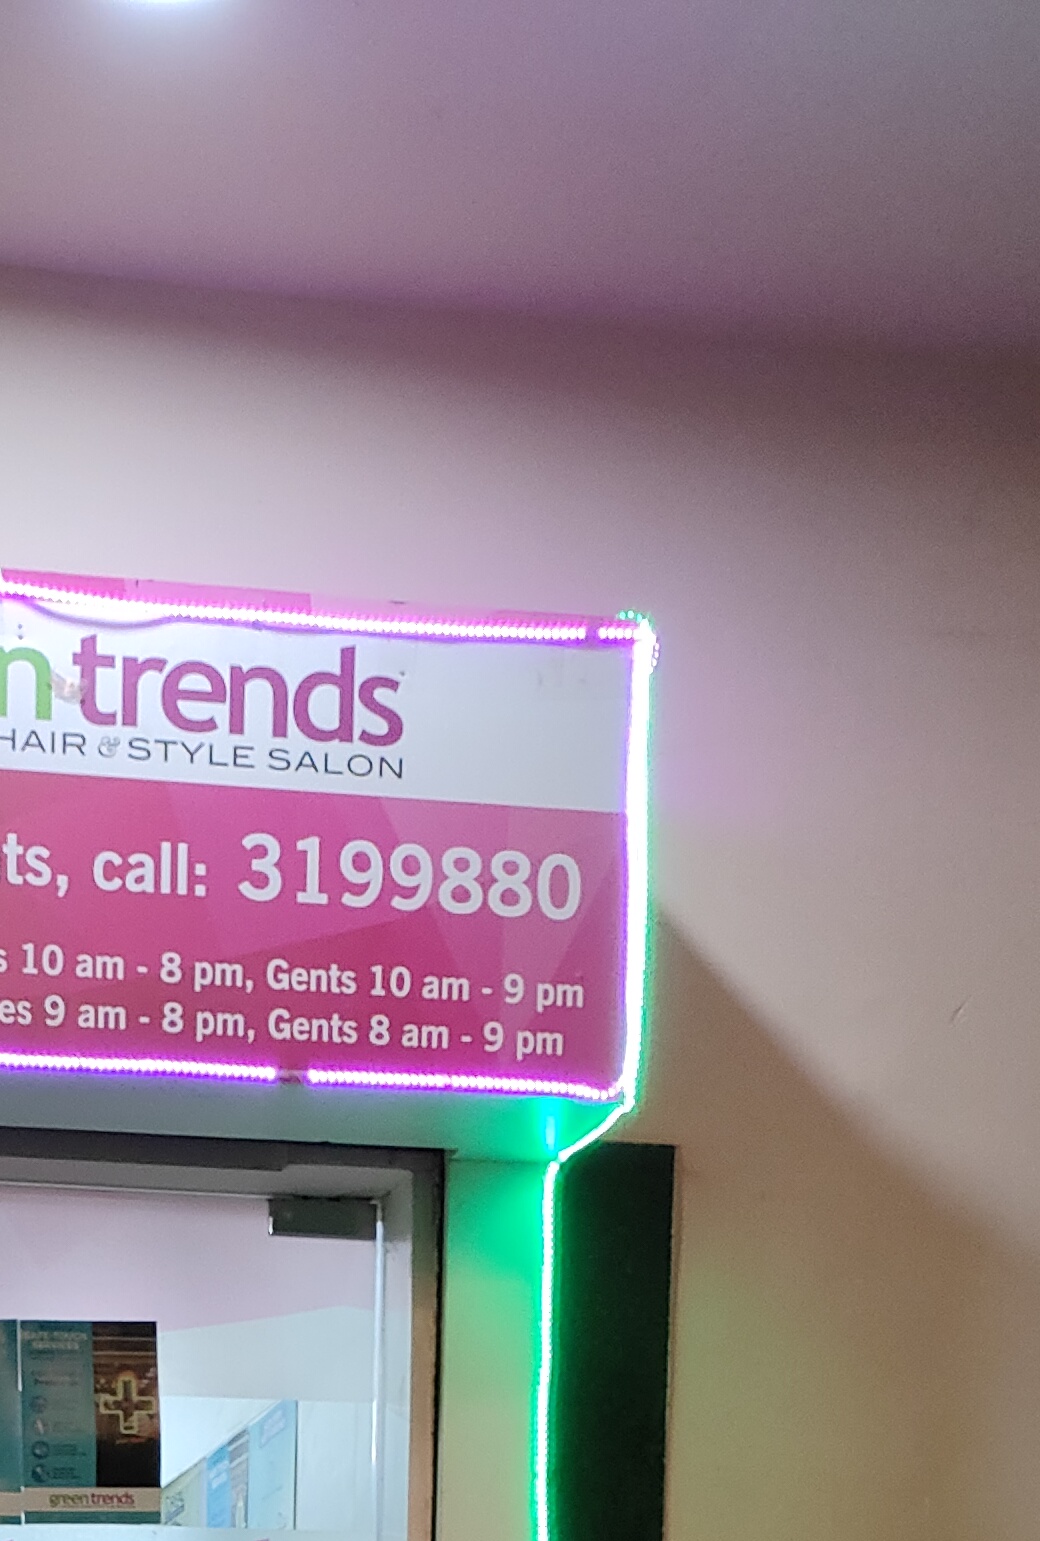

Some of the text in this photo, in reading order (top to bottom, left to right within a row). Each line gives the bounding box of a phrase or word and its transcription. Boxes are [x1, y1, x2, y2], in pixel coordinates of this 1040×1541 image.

[72, 634, 404, 747] trends
[97, 735, 120, 758] &
[128, 738, 255, 770] STYLE
[268, 749, 404, 780] SALON
[92, 841, 207, 898] call:
[238, 832, 581, 921] 3199880
[22, 943, 64, 976] 10
[75, 952, 125, 981] am
[160, 951, 182, 983] 8
[195, 959, 254, 993] pm,
[266, 958, 357, 996] Gents
[370, 965, 412, 998] 10
[421, 973, 470, 1001] am
[504, 974, 524, 1005] 9
[537, 980, 584, 1013] pm
[44, 994, 64, 1027] 9
[77, 1003, 127, 1031] am
[161, 1002, 184, 1035] 8
[195, 1010, 256, 1042] pm,
[268, 1008, 358, 1045] Gents
[369, 1015, 391, 1046] 8
[401, 1022, 450, 1050] am
[483, 1021, 505, 1053] 9
[516, 1029, 564, 1061] pm
[48, 1491, 135, 1508] green trends
